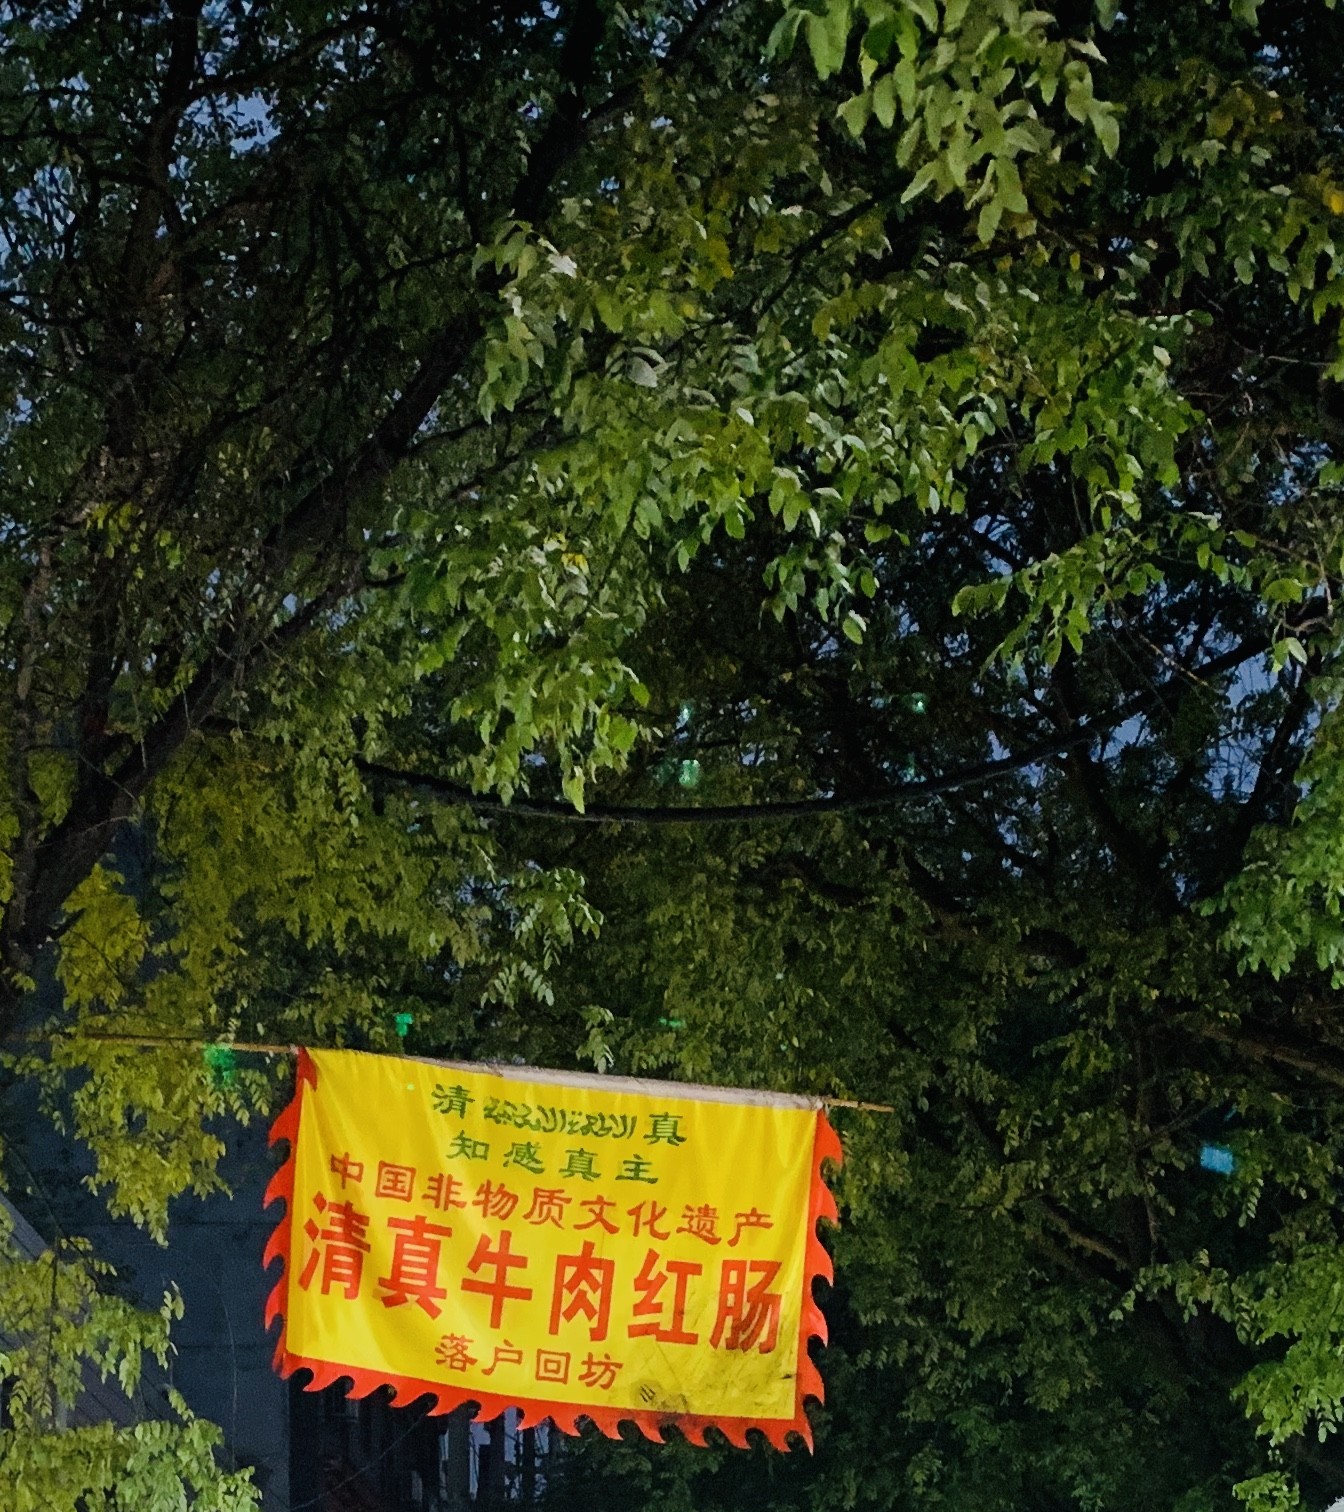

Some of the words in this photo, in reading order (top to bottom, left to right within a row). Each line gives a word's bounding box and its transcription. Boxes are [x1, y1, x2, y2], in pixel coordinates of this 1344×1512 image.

[431, 1085, 474, 1118] 清
[643, 1112, 687, 1146] 真
[446, 1131, 658, 1184] 知感真主
[330, 1152, 773, 1248] 中国非物质文化遗产
[298, 1190, 783, 1355] 清真牛肉红肠
[434, 1332, 624, 1390] 落户回坊
